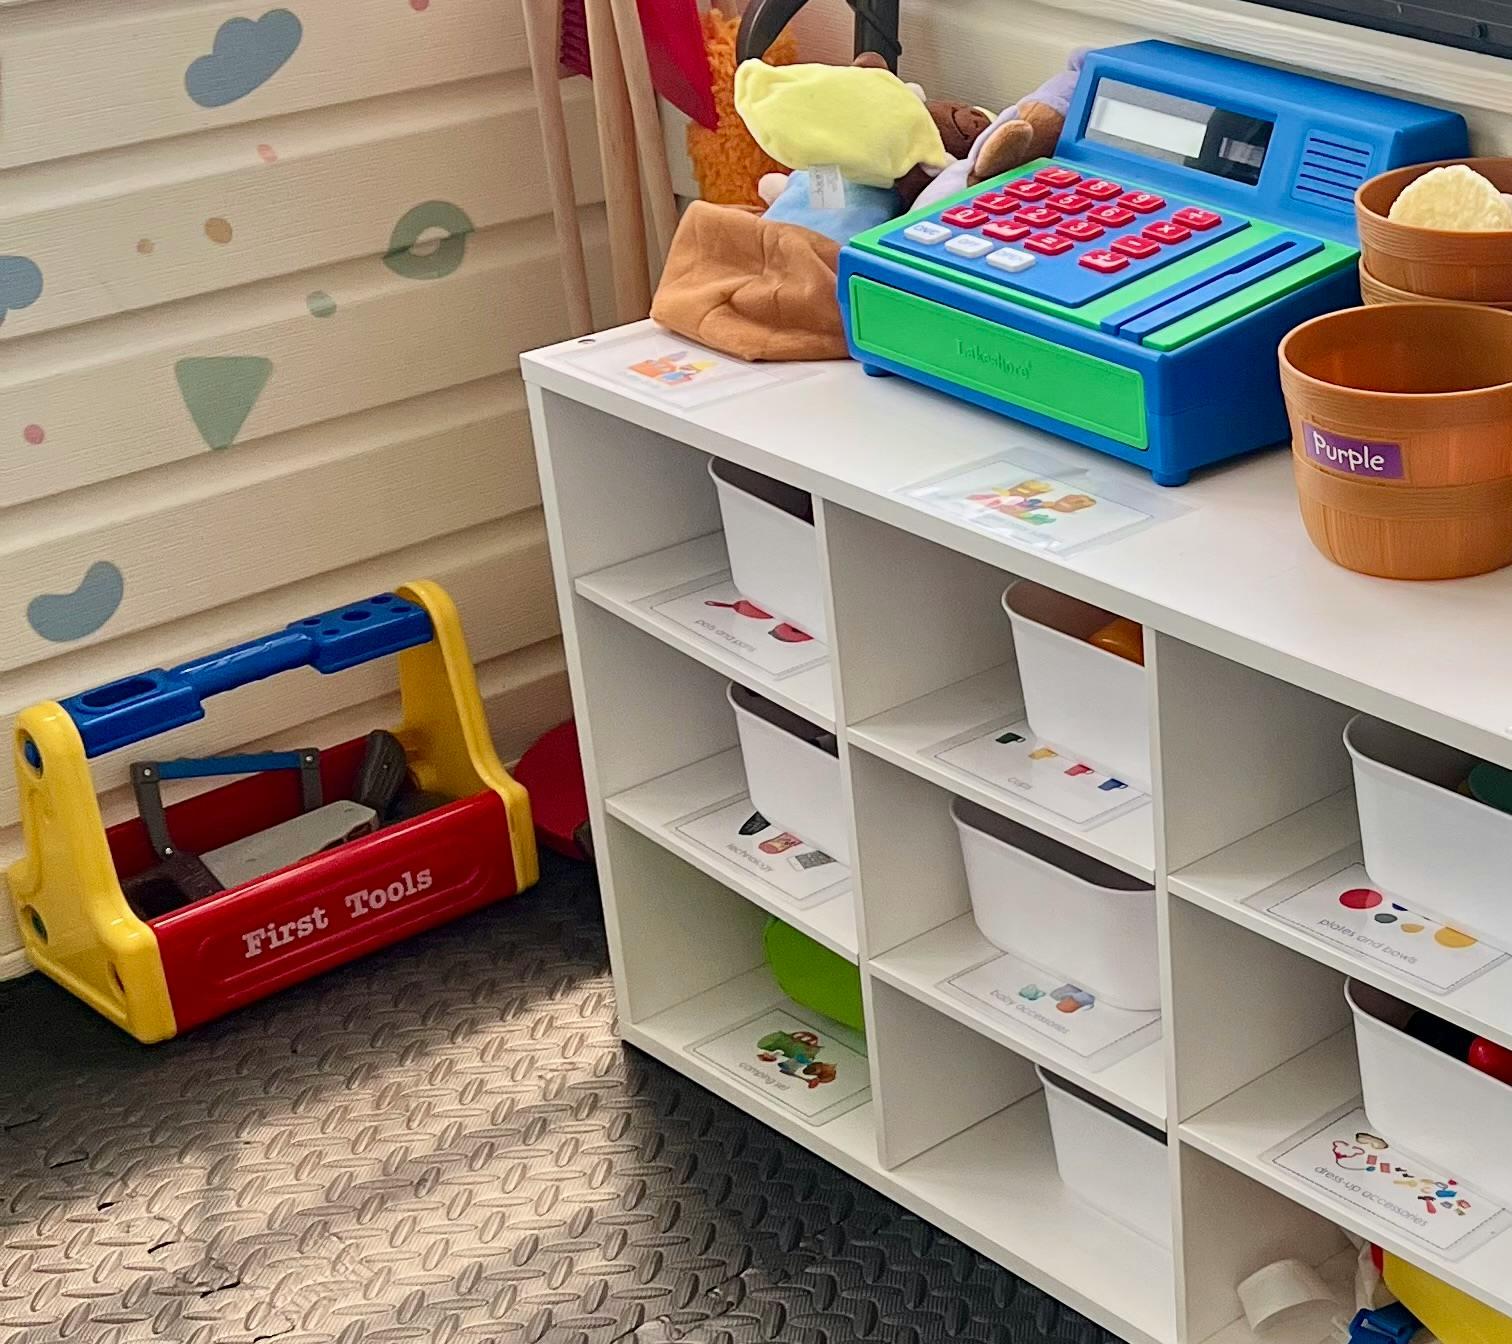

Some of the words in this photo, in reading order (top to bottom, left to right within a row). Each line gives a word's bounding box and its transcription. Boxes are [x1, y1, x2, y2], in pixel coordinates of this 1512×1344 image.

[1058, 195, 1079, 205] 5
[1100, 207, 1121, 217] 6
[1089, 181, 1109, 191] 8
[1132, 194, 1151, 204] 9
[1027, 208, 1048, 219] 2
[1069, 222, 1089, 232] 3
[1312, 430, 1385, 472] Purple
[241, 906, 329, 959] First
[344, 868, 433, 919] Tools
[1317, 918, 1355, 937] plates
[1356, 935, 1384, 949] and
[1314, 1165, 1362, 1193] dress-up
[1361, 1190, 1428, 1227] accessories
